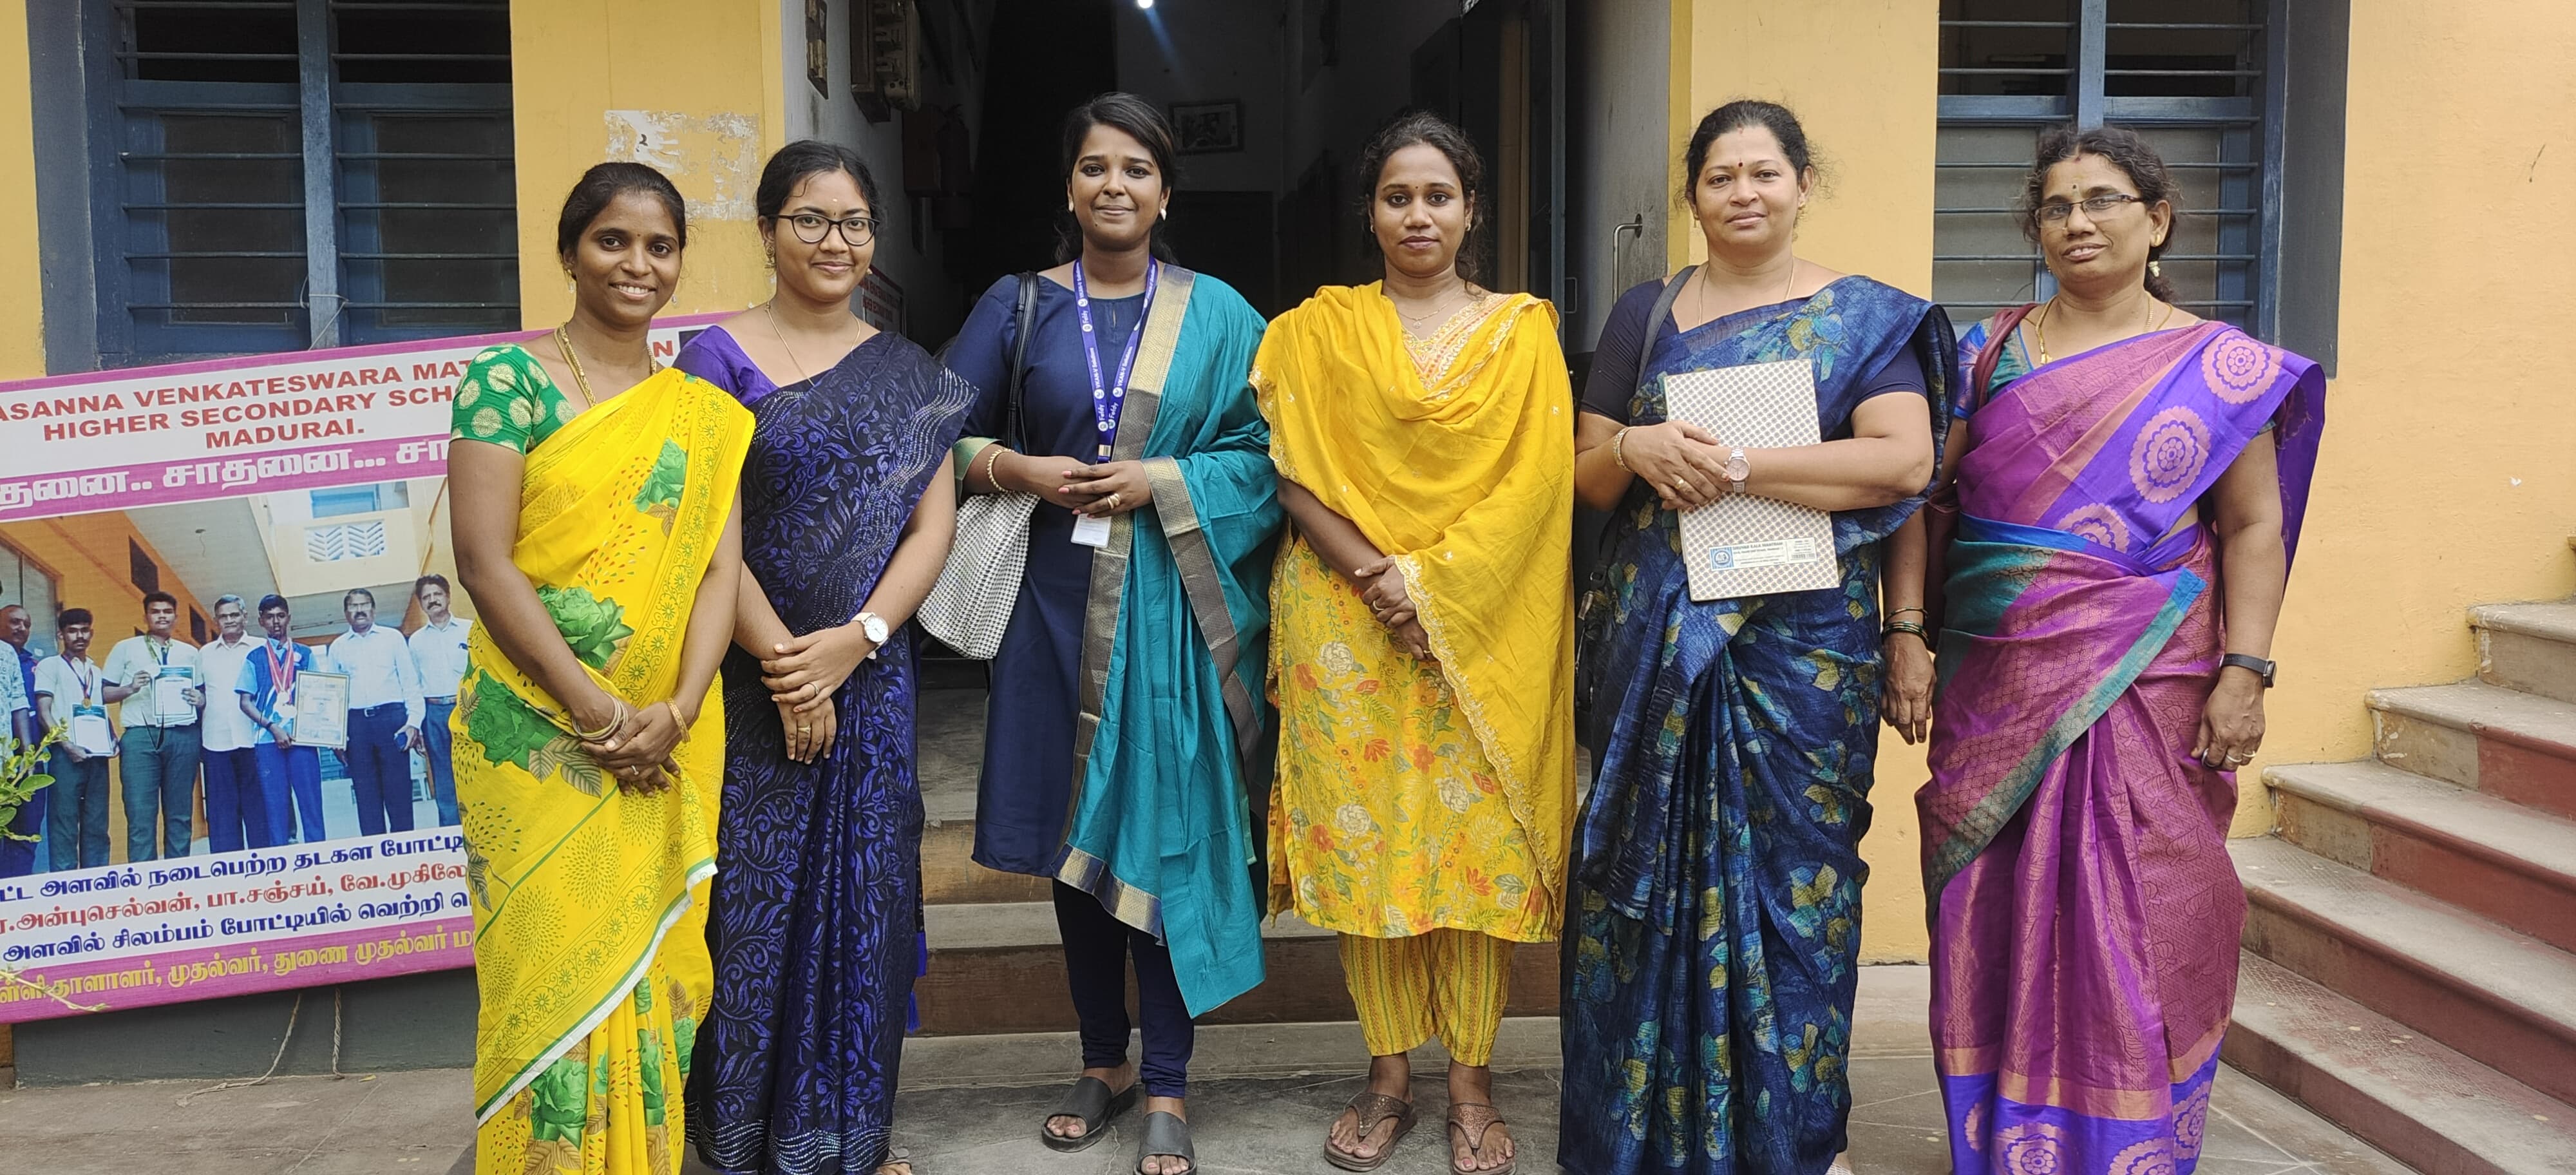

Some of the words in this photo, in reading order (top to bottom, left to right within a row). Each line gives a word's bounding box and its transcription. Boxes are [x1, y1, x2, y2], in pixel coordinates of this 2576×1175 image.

[133, 367, 402, 408] VENKATESWARA
[44, 412, 169, 441] HIGHER
[181, 392, 377, 428] SECONDARY
[388, 385, 459, 406] SCH
[205, 418, 365, 450] MADURAI.
[163, 448, 386, 491] சாதனை...
[40, 867, 142, 897] அளவில்
[148, 852, 287, 890] நடைபெற்ற
[293, 845, 374, 872] தடகள
[207, 875, 334, 908] பா.சஞ்சய்,
[3, 931, 106, 962] அளவில்
[113, 919, 214, 949] சிலம்பம்
[221, 903, 352, 935] போட்டியில்
[358, 891, 444, 920] வெற்றி
[167, 947, 269, 988] முதல்வர்,
[274, 945, 348, 977] துணை
[355, 924, 448, 965] முதல்வர்
